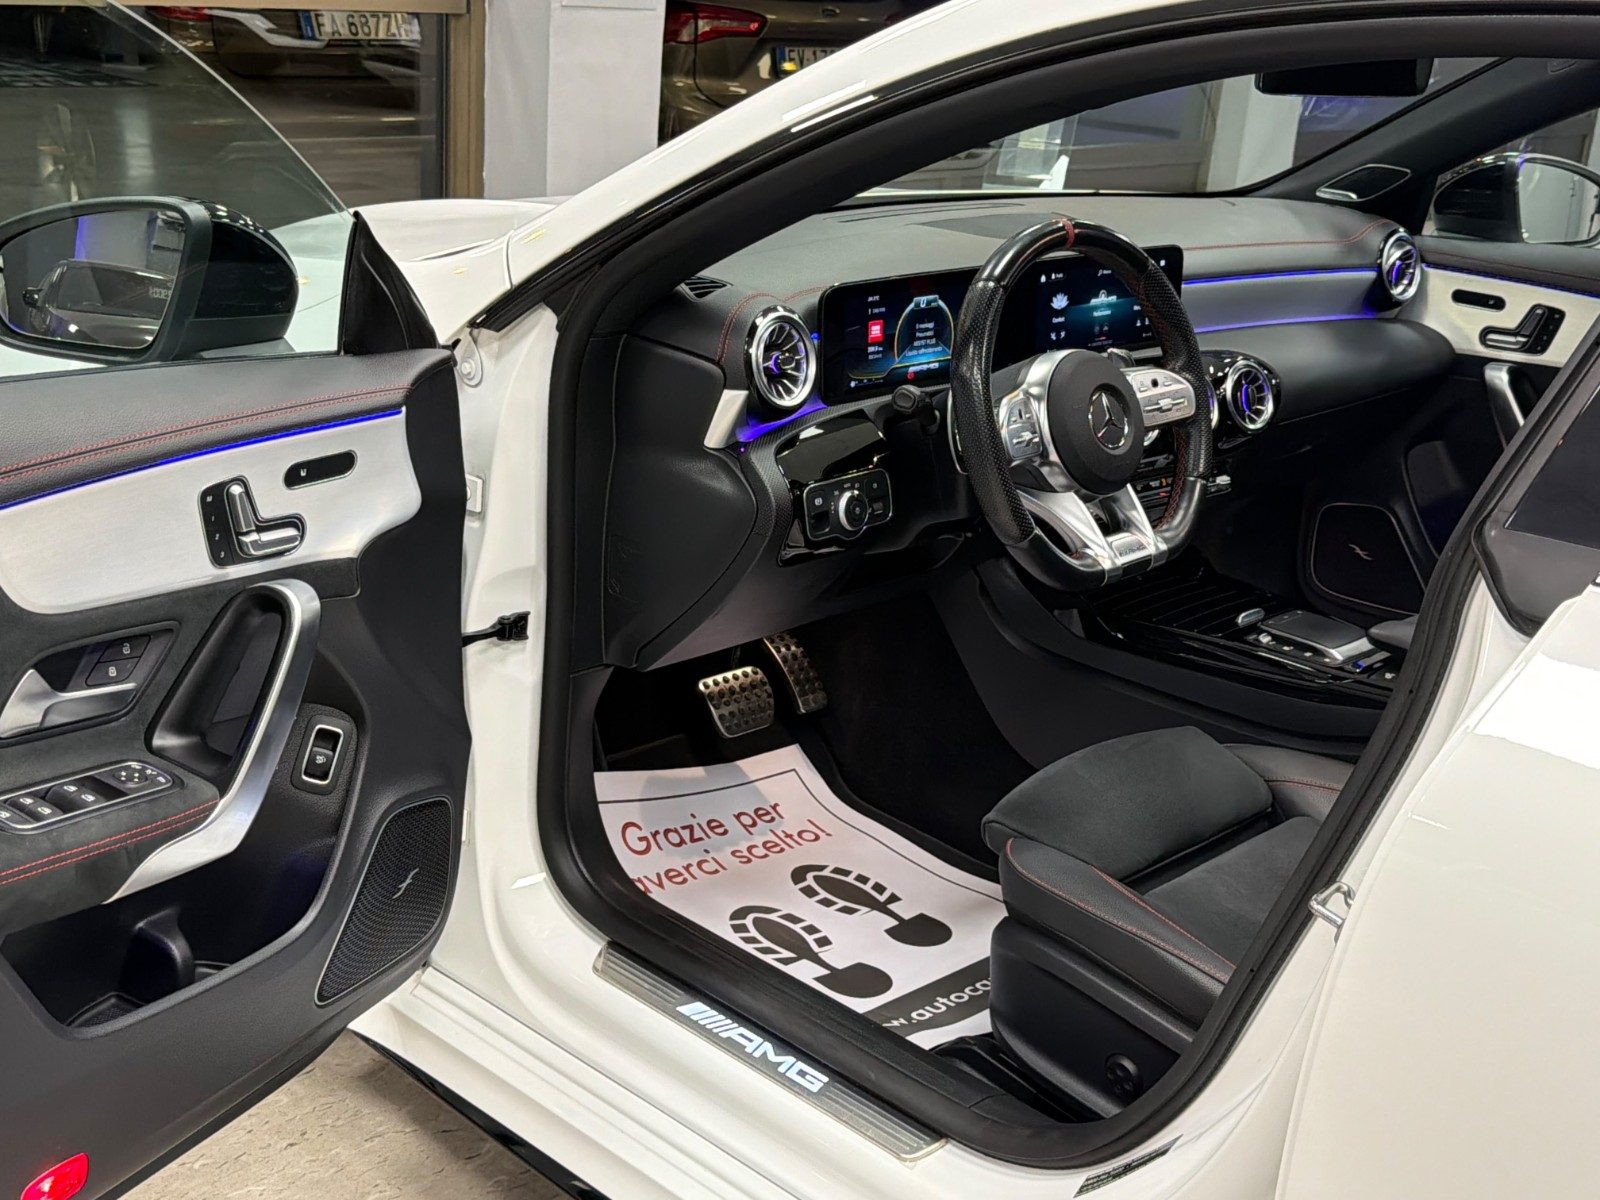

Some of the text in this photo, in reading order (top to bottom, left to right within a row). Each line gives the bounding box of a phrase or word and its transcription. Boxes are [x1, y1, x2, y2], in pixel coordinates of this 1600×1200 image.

[620, 802, 785, 857] Grazie per
[730, 818, 833, 865] scelto!
[881, 977, 992, 1028] w.autoca
[717, 1026, 830, 1093] AMG
